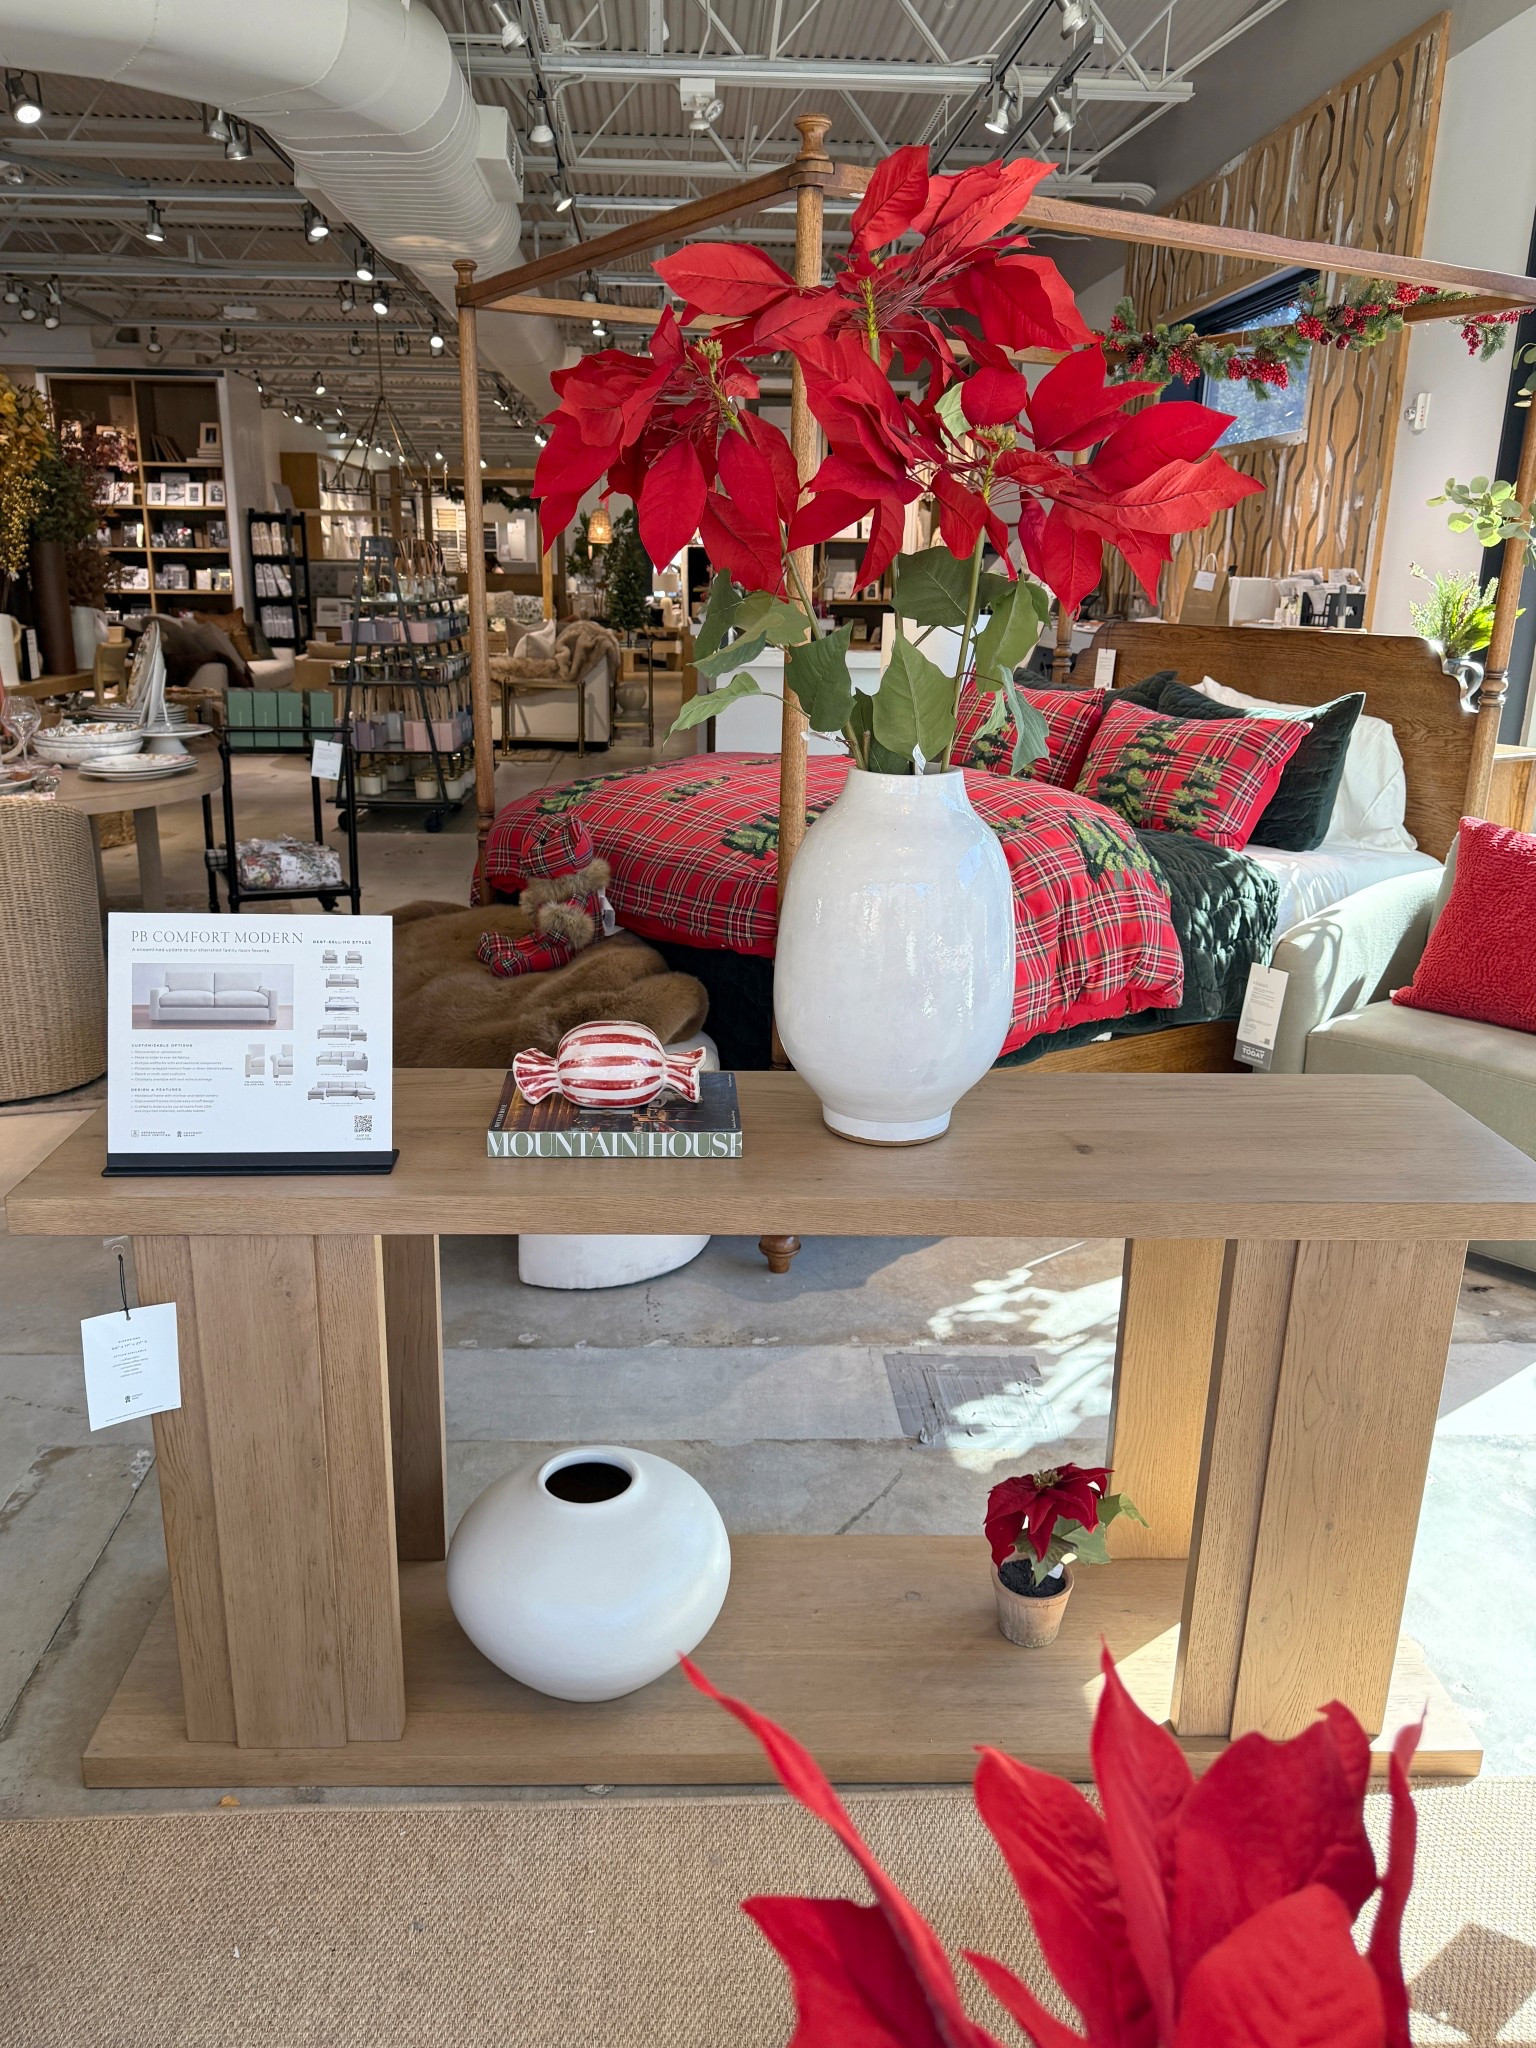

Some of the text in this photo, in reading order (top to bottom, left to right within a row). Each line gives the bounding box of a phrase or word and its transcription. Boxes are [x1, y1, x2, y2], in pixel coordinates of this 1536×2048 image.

[132, 930, 303, 944] PB COMFORT MODERN
[1242, 1048, 1265, 1059] TODAY
[488, 1132, 639, 1157] MOUNTAIN
[646, 1132, 742, 1157] HOUSE
